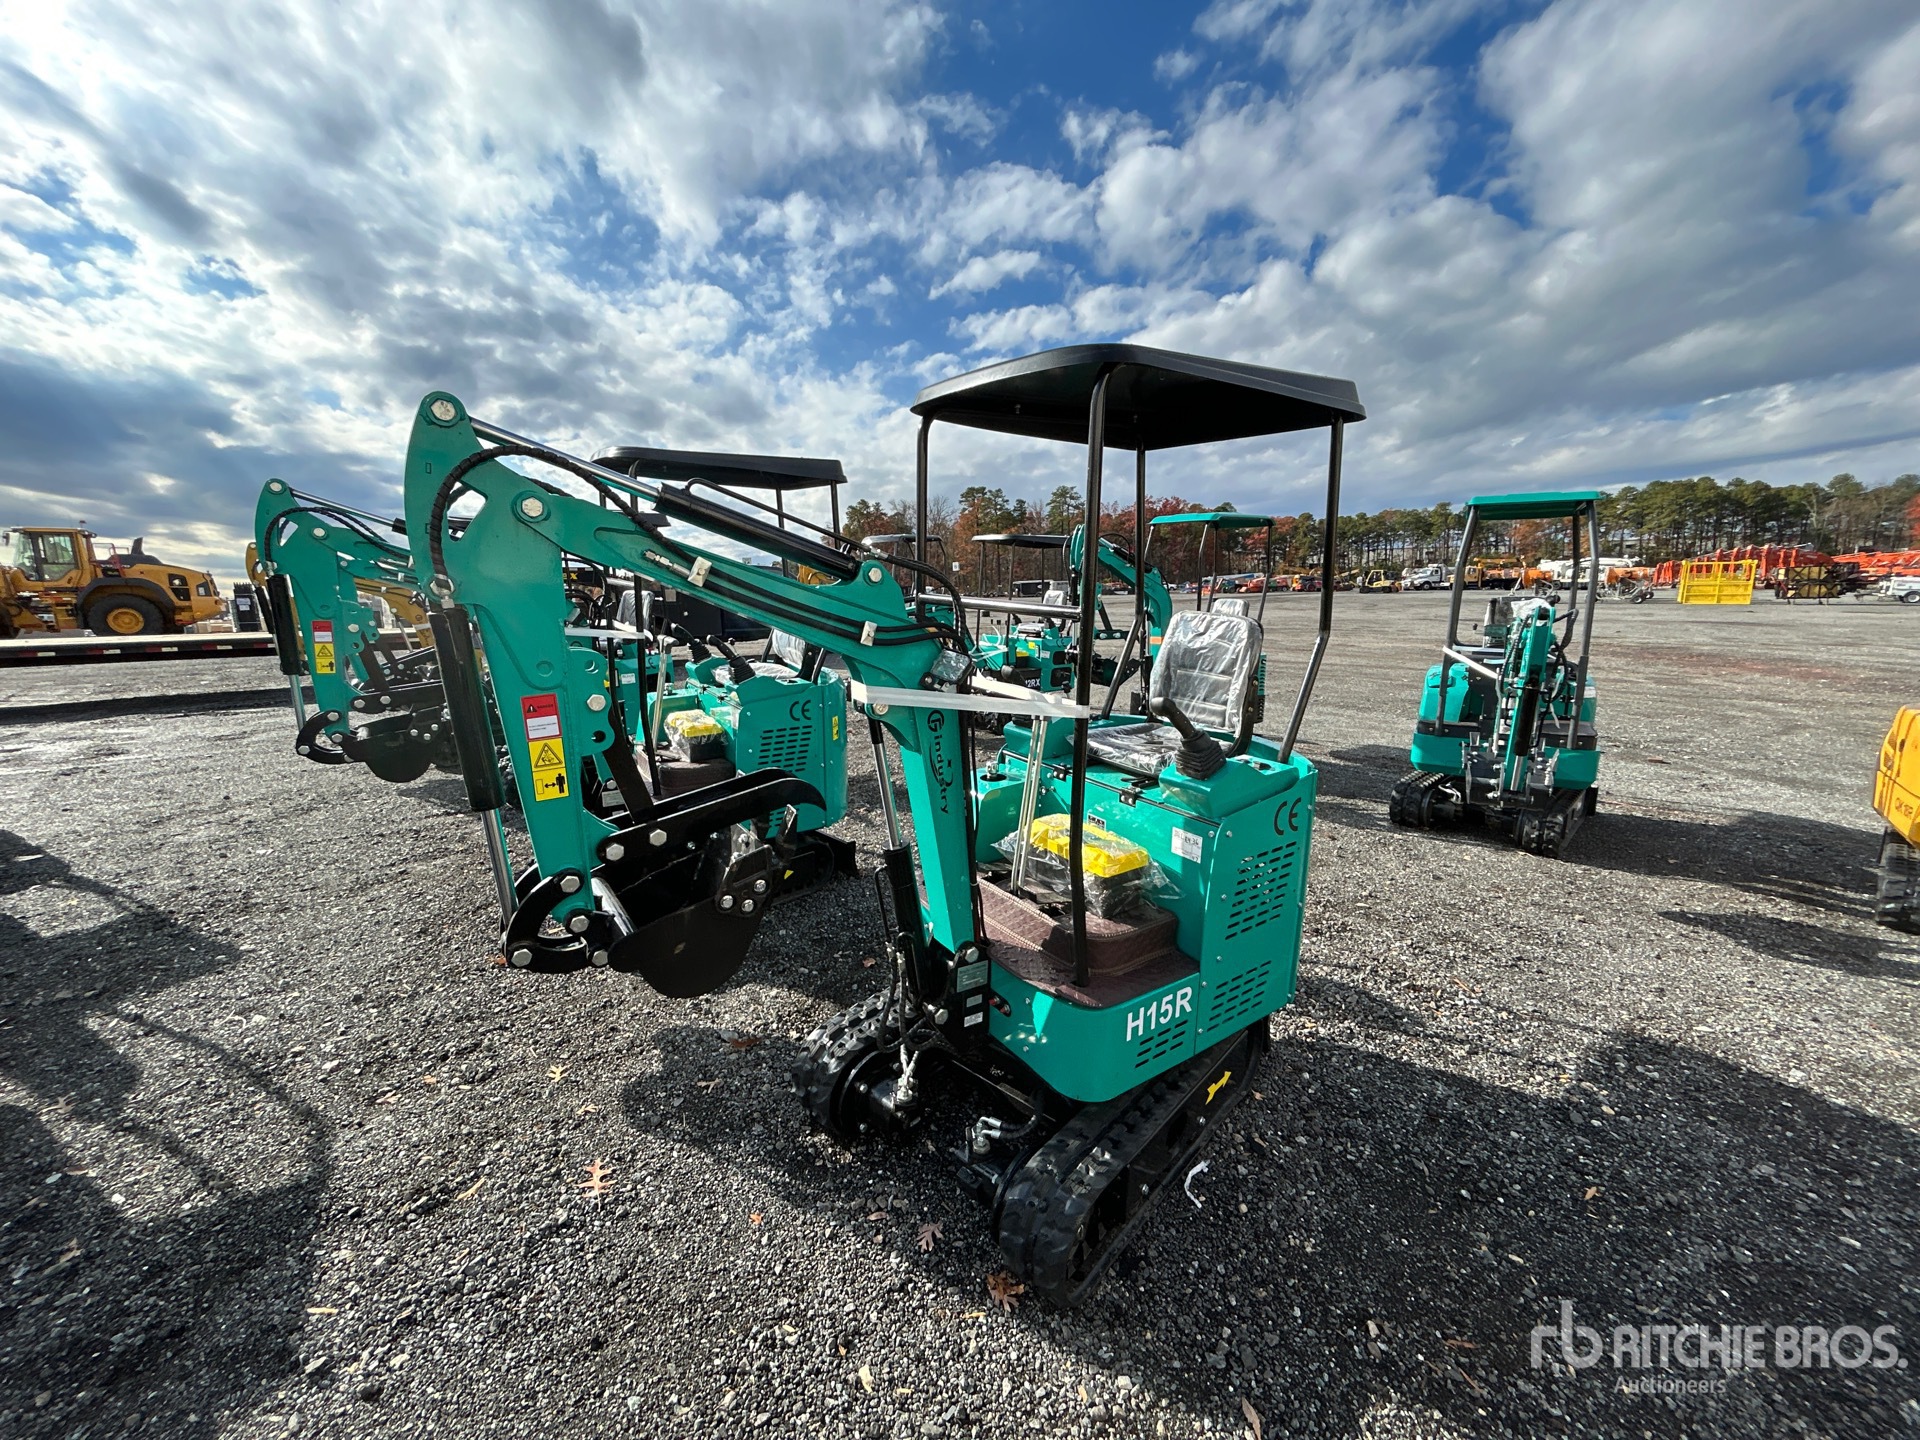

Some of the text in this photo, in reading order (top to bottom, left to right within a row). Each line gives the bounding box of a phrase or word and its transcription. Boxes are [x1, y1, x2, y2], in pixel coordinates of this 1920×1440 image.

[789, 699, 812, 722] CE
[1273, 797, 1302, 836] CE
[1126, 986, 1193, 1042] H15R
